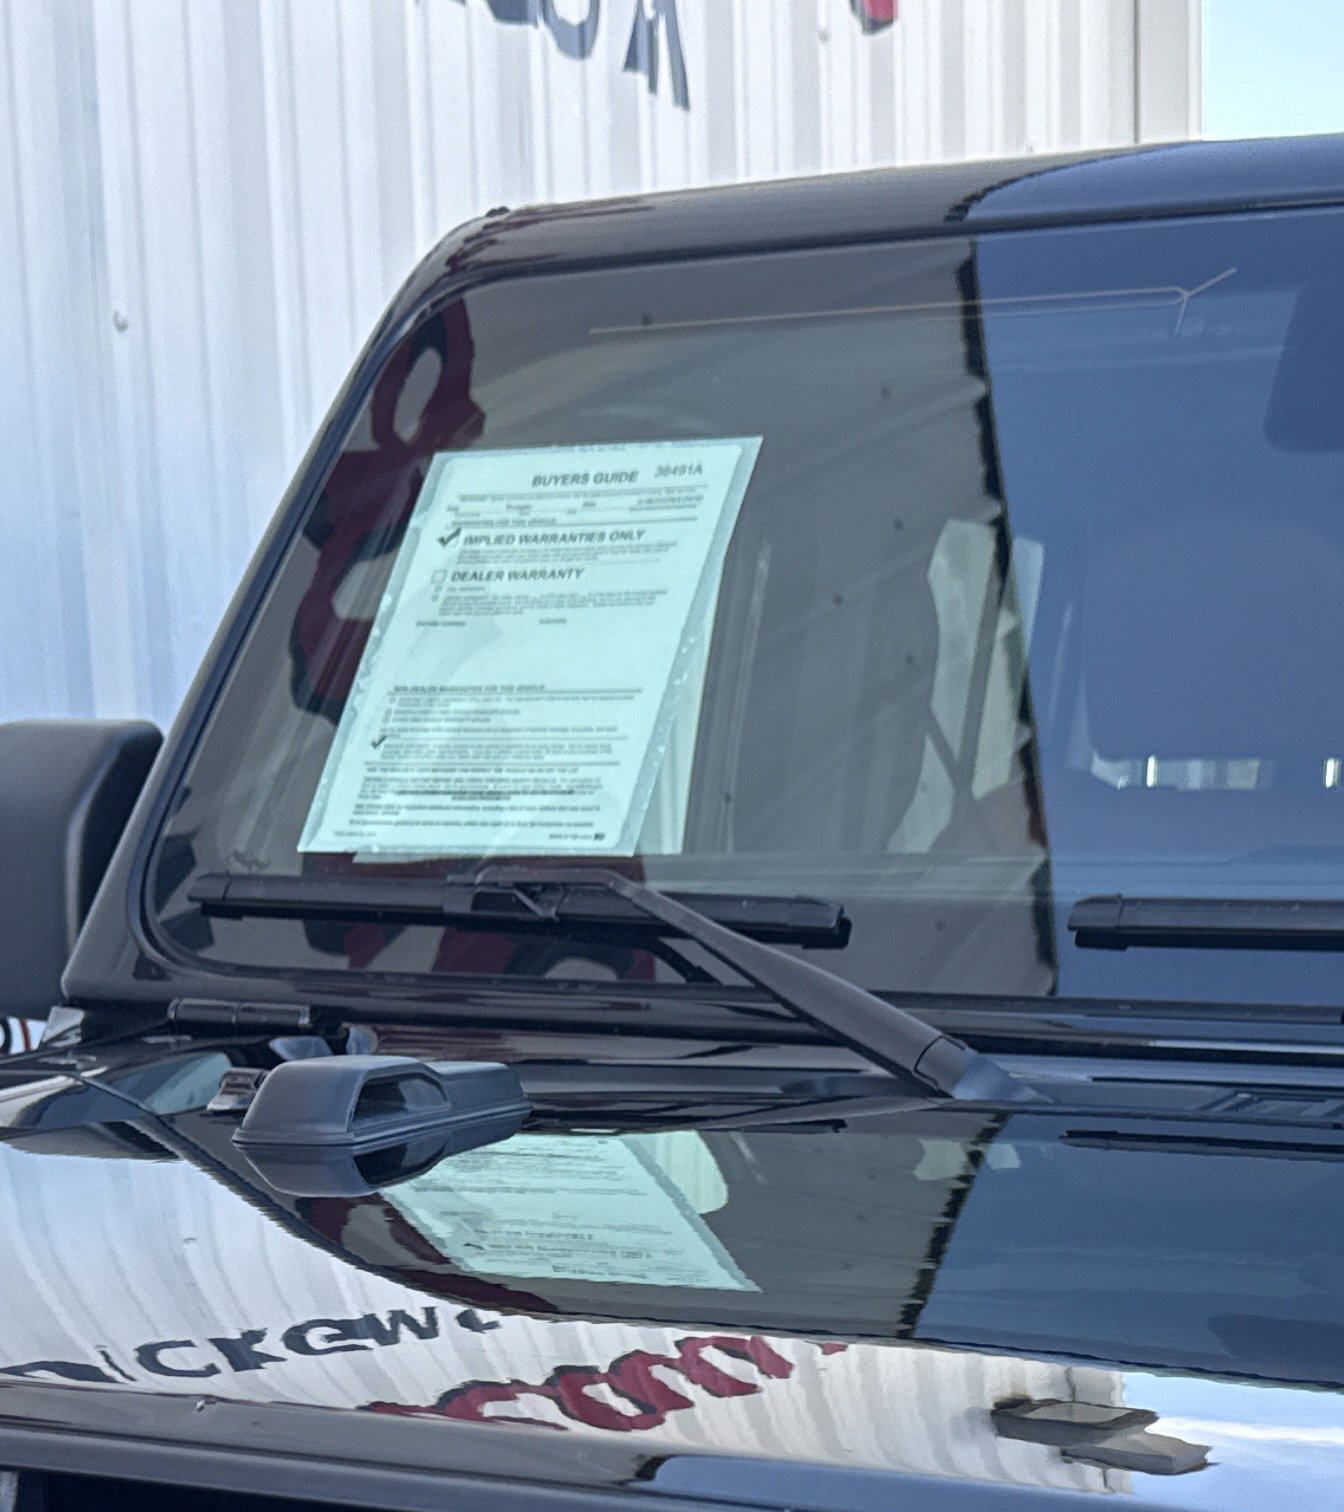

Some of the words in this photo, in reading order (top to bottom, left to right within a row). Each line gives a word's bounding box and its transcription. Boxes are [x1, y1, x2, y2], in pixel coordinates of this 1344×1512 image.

[531, 474, 589, 487] BUYERS
[593, 470, 639, 485] GUIDE
[463, 533, 516, 546] IMPLIED
[518, 530, 605, 545] WARRANTIES
[609, 529, 646, 542] ONLY
[451, 570, 505, 582] DEALER
[507, 567, 585, 581] WARRANTY
